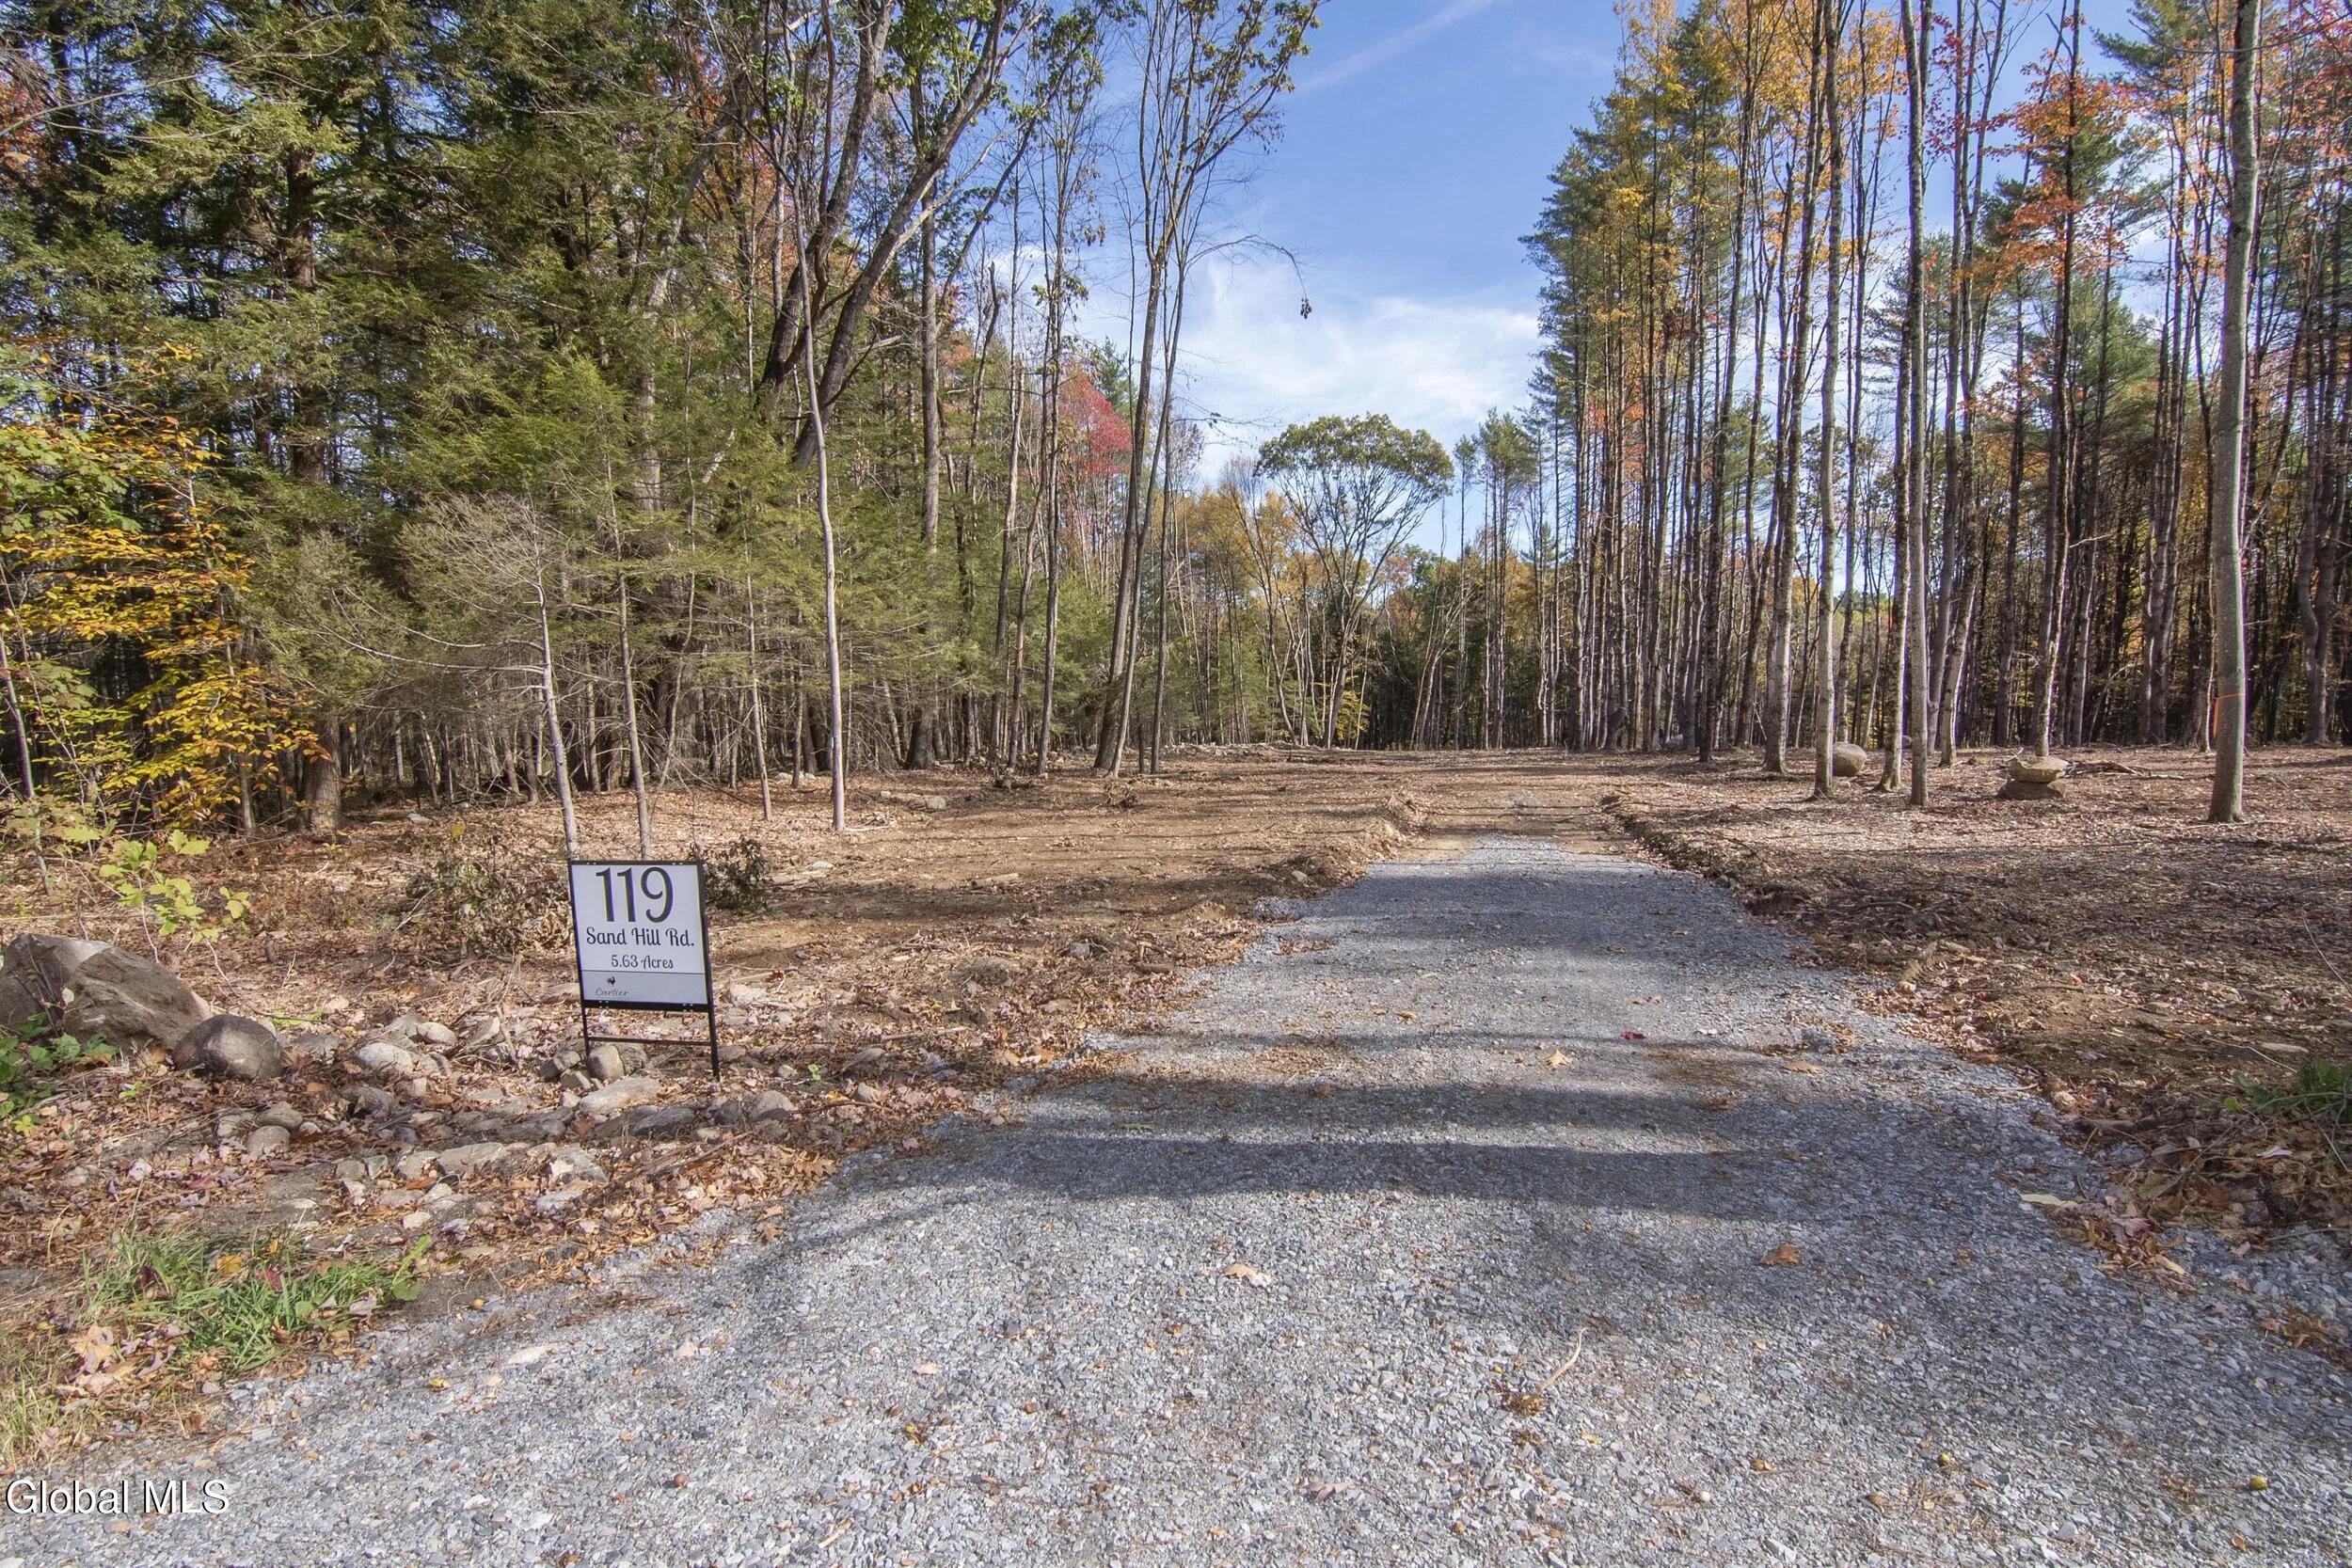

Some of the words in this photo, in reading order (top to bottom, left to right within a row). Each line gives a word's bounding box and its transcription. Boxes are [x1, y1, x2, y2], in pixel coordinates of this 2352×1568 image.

[596, 866, 674, 924] 119
[586, 927, 627, 945] Sand
[631, 927, 661, 946] Hill
[665, 927, 695, 946] Rd.
[611, 954, 638, 968] 5.63
[640, 955, 674, 969] Acres
